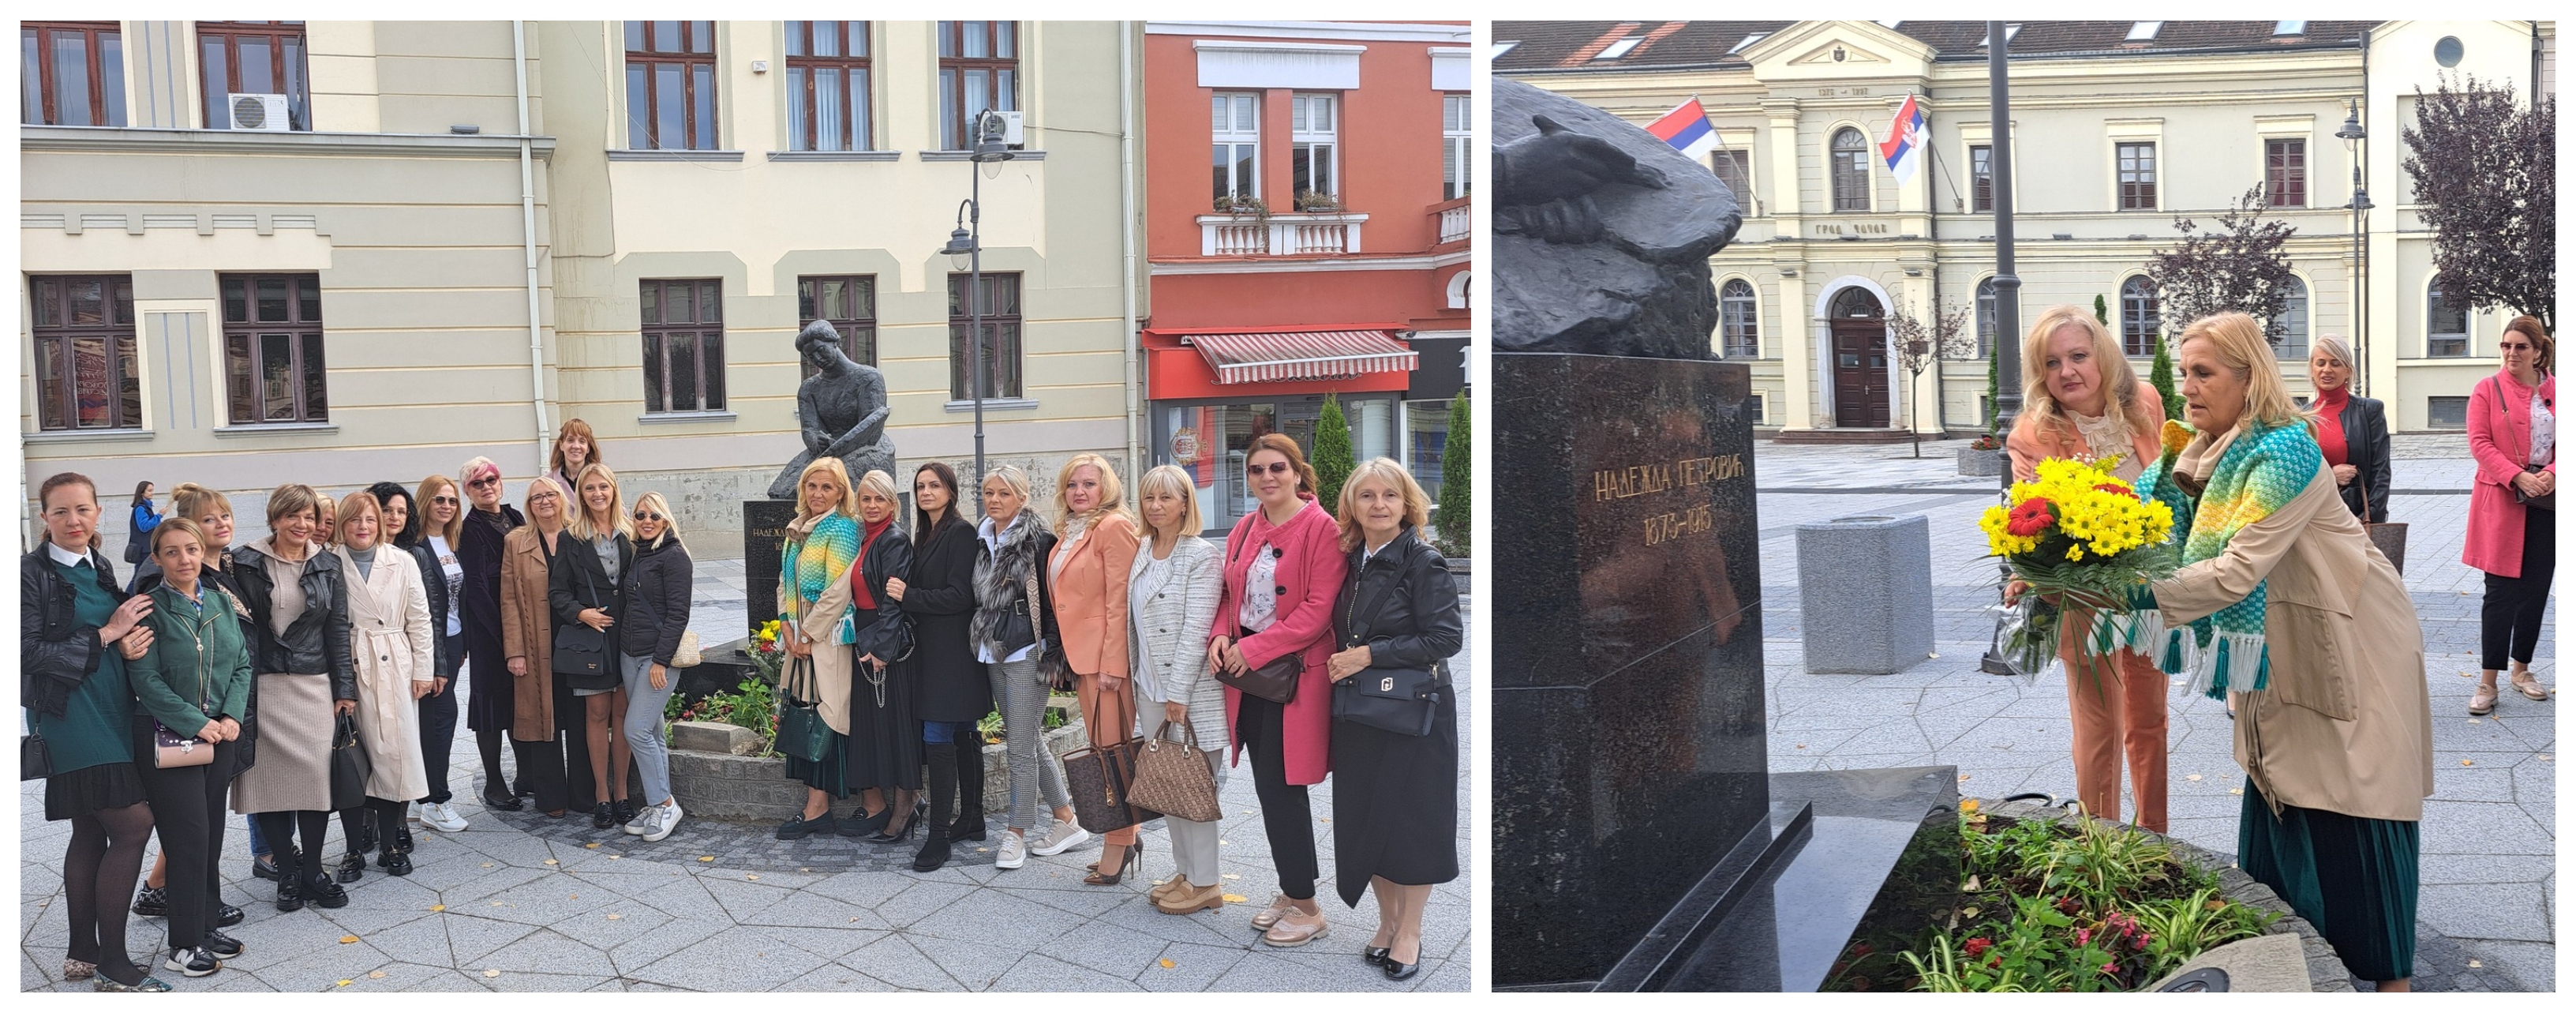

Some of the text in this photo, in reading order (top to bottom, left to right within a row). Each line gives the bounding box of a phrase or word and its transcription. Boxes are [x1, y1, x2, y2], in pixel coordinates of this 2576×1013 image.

[1816, 223, 1843, 234] ГРАД
[1594, 453, 1745, 501] НАДЕЖДА ПЕТРОВИЋ
[753, 528, 786, 537] НАДЕЖД
